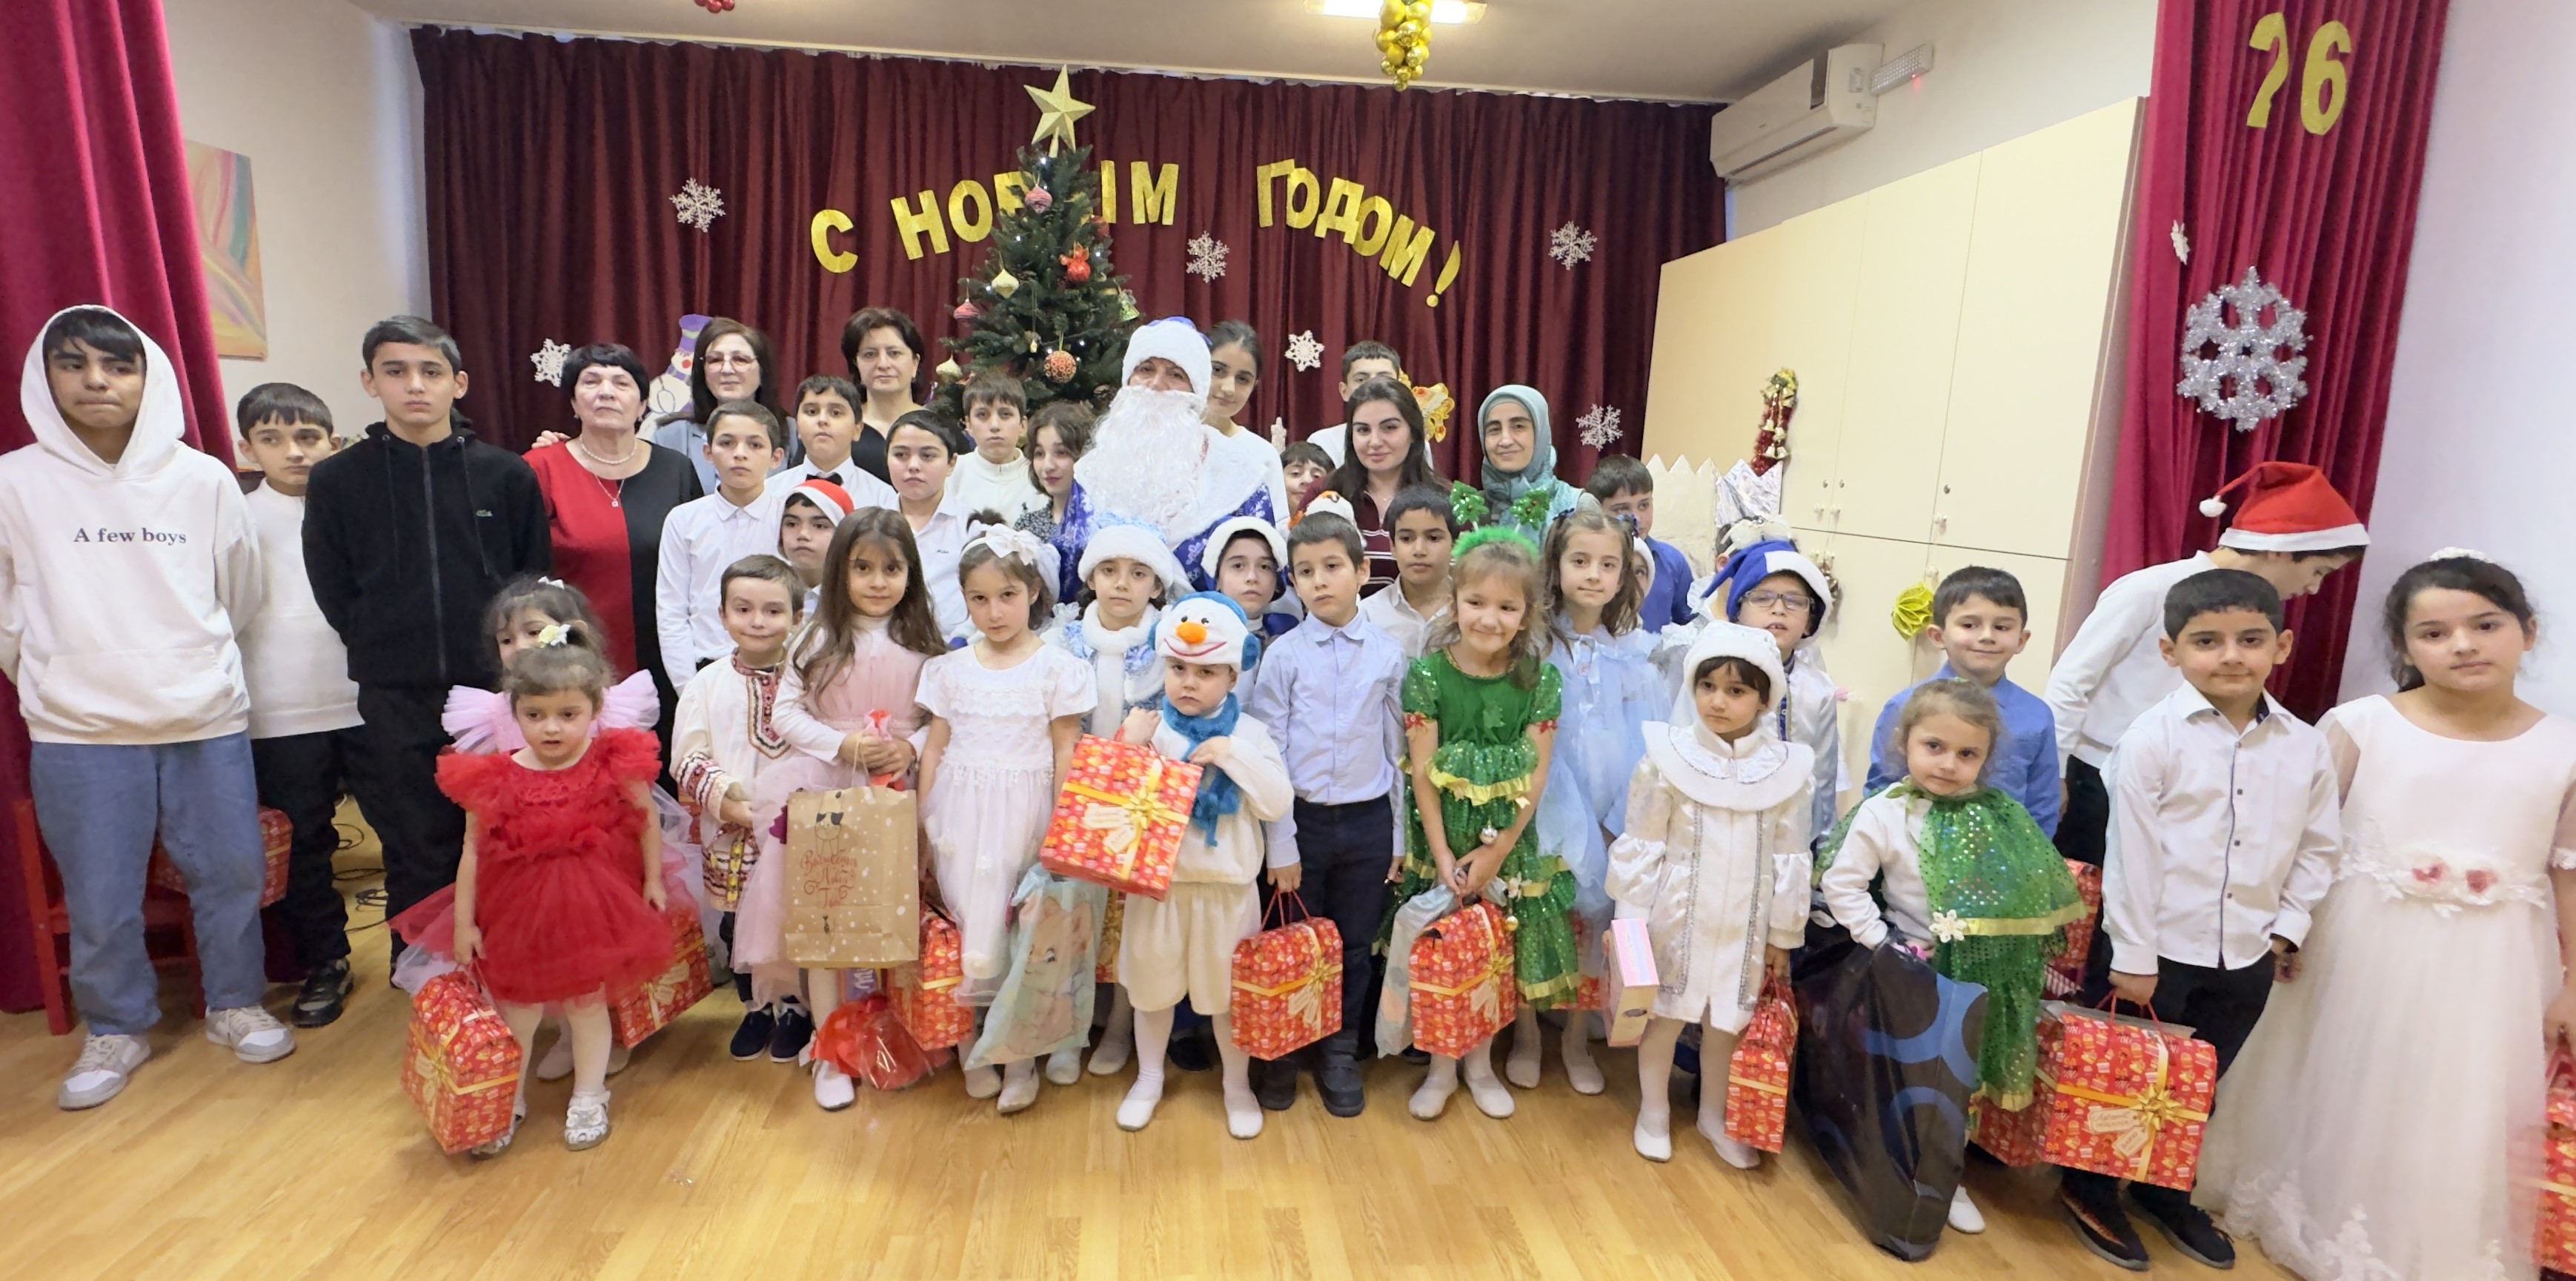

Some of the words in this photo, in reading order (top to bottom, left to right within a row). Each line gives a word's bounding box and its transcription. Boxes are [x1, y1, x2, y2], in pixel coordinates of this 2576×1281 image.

[811, 209, 858, 274] С
[1256, 158, 1461, 308] ГОДОМ!
[73, 527, 90, 543] A
[97, 527, 136, 543] few
[142, 527, 187, 546] boys
